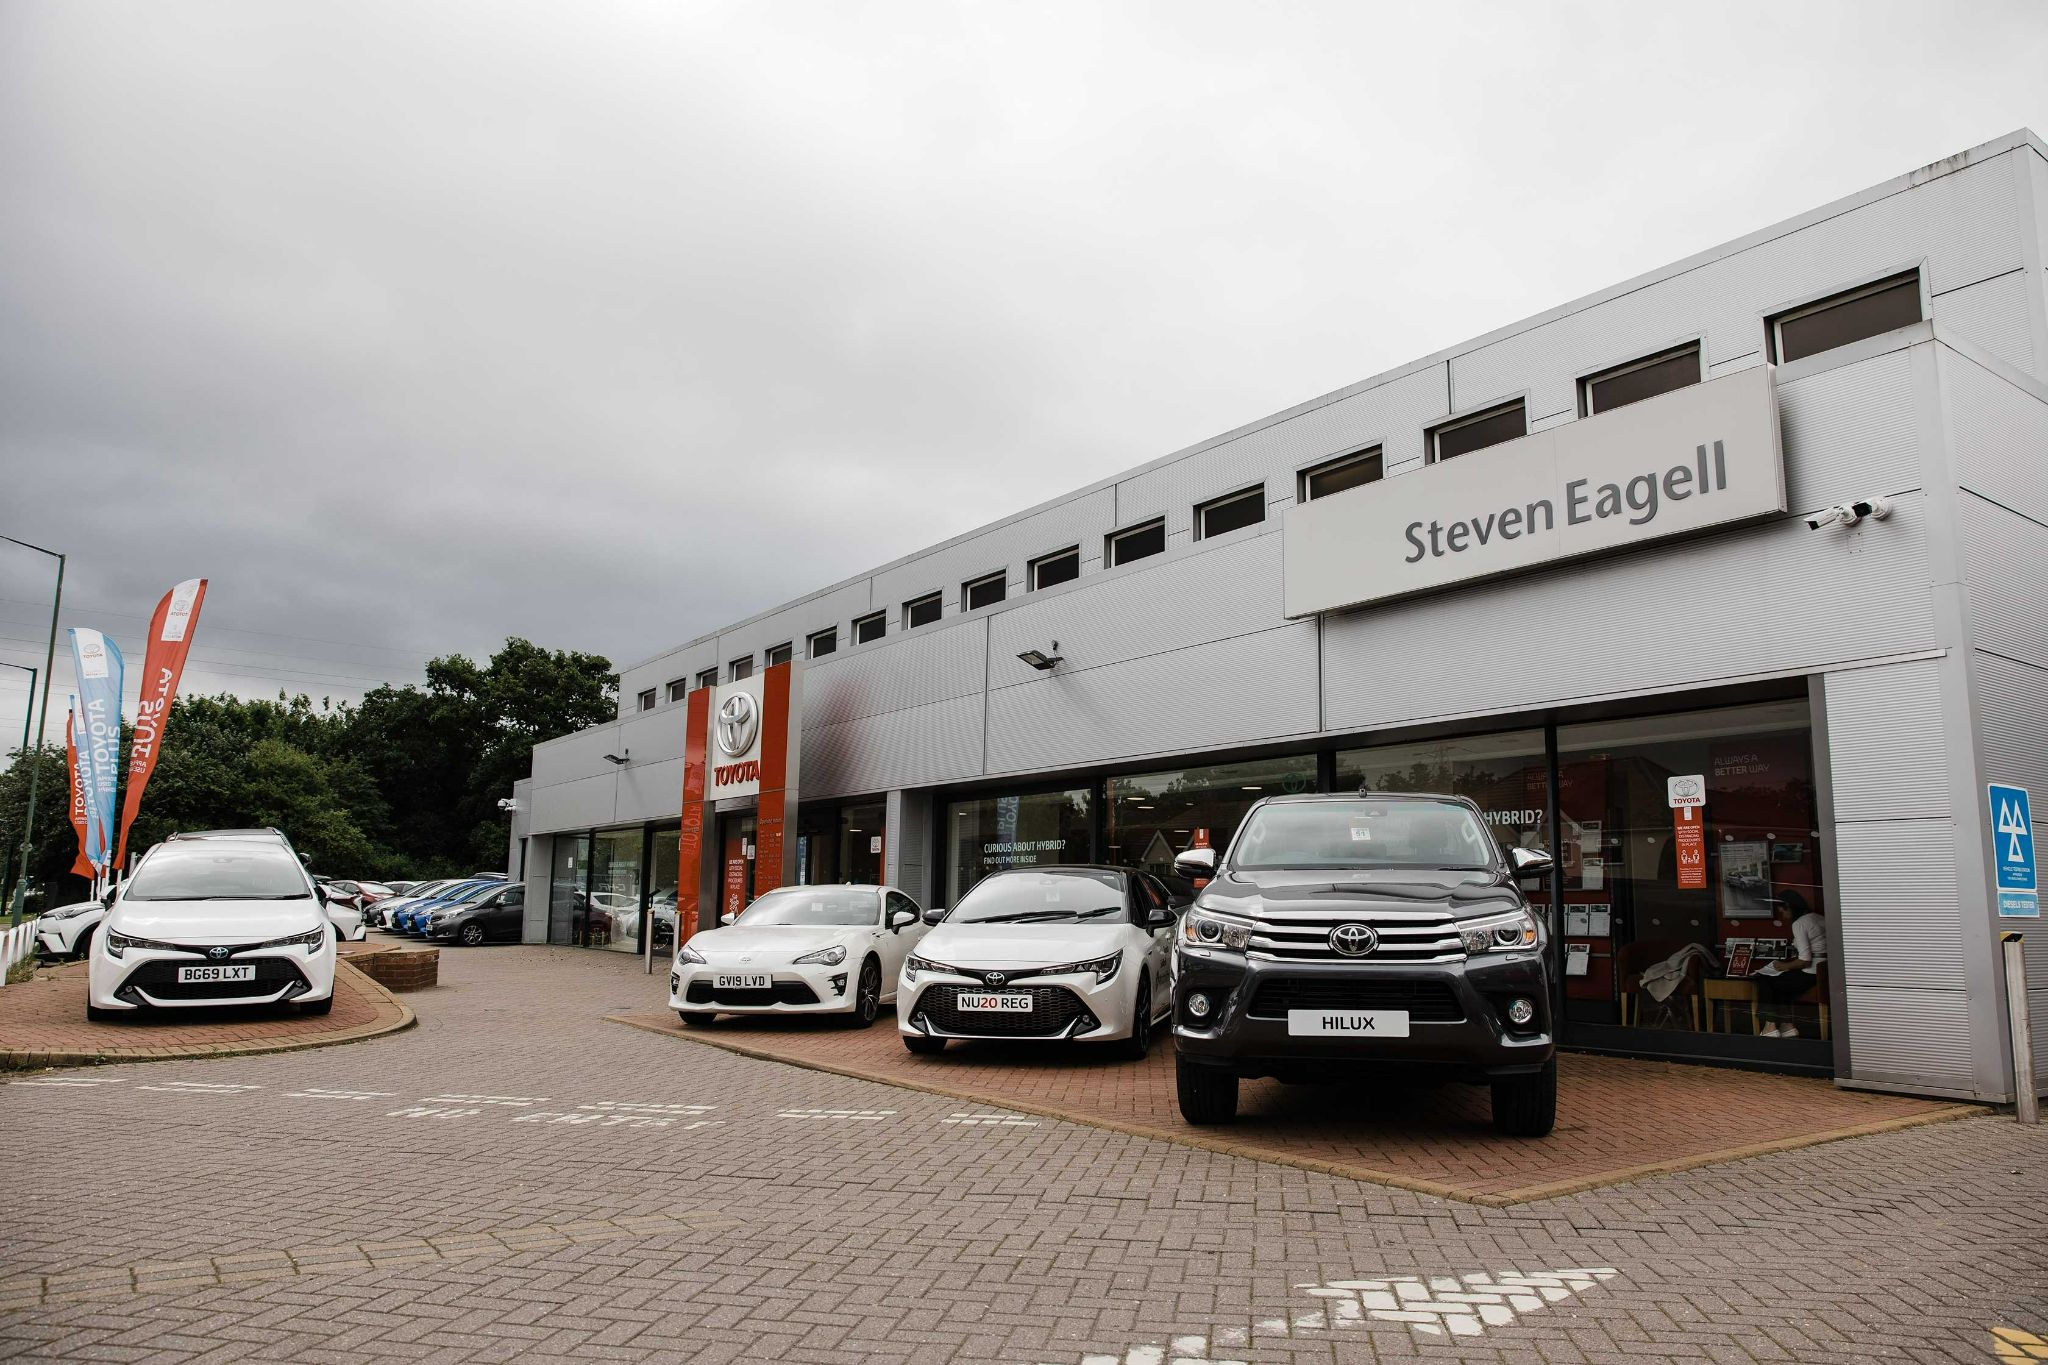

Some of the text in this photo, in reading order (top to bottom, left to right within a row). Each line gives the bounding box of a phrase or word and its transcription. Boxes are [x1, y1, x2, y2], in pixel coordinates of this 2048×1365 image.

[1404, 439, 1727, 563] Steven Eagell
[88, 698, 110, 775] TOYOTA
[714, 760, 760, 786] TOYOTA
[1714, 763, 1770, 776] BETTER WAY
[1673, 797, 1701, 805] TOYOTA
[1483, 808, 1543, 825] HYBRID?
[984, 840, 1066, 853] CURIOUS ABOUT HYBRID?
[184, 967, 249, 980] BG69 LXT
[719, 975, 765, 987] GV19 LVD
[961, 997, 1028, 1008] NU20 REG
[1322, 1017, 1375, 1030] HILUX
